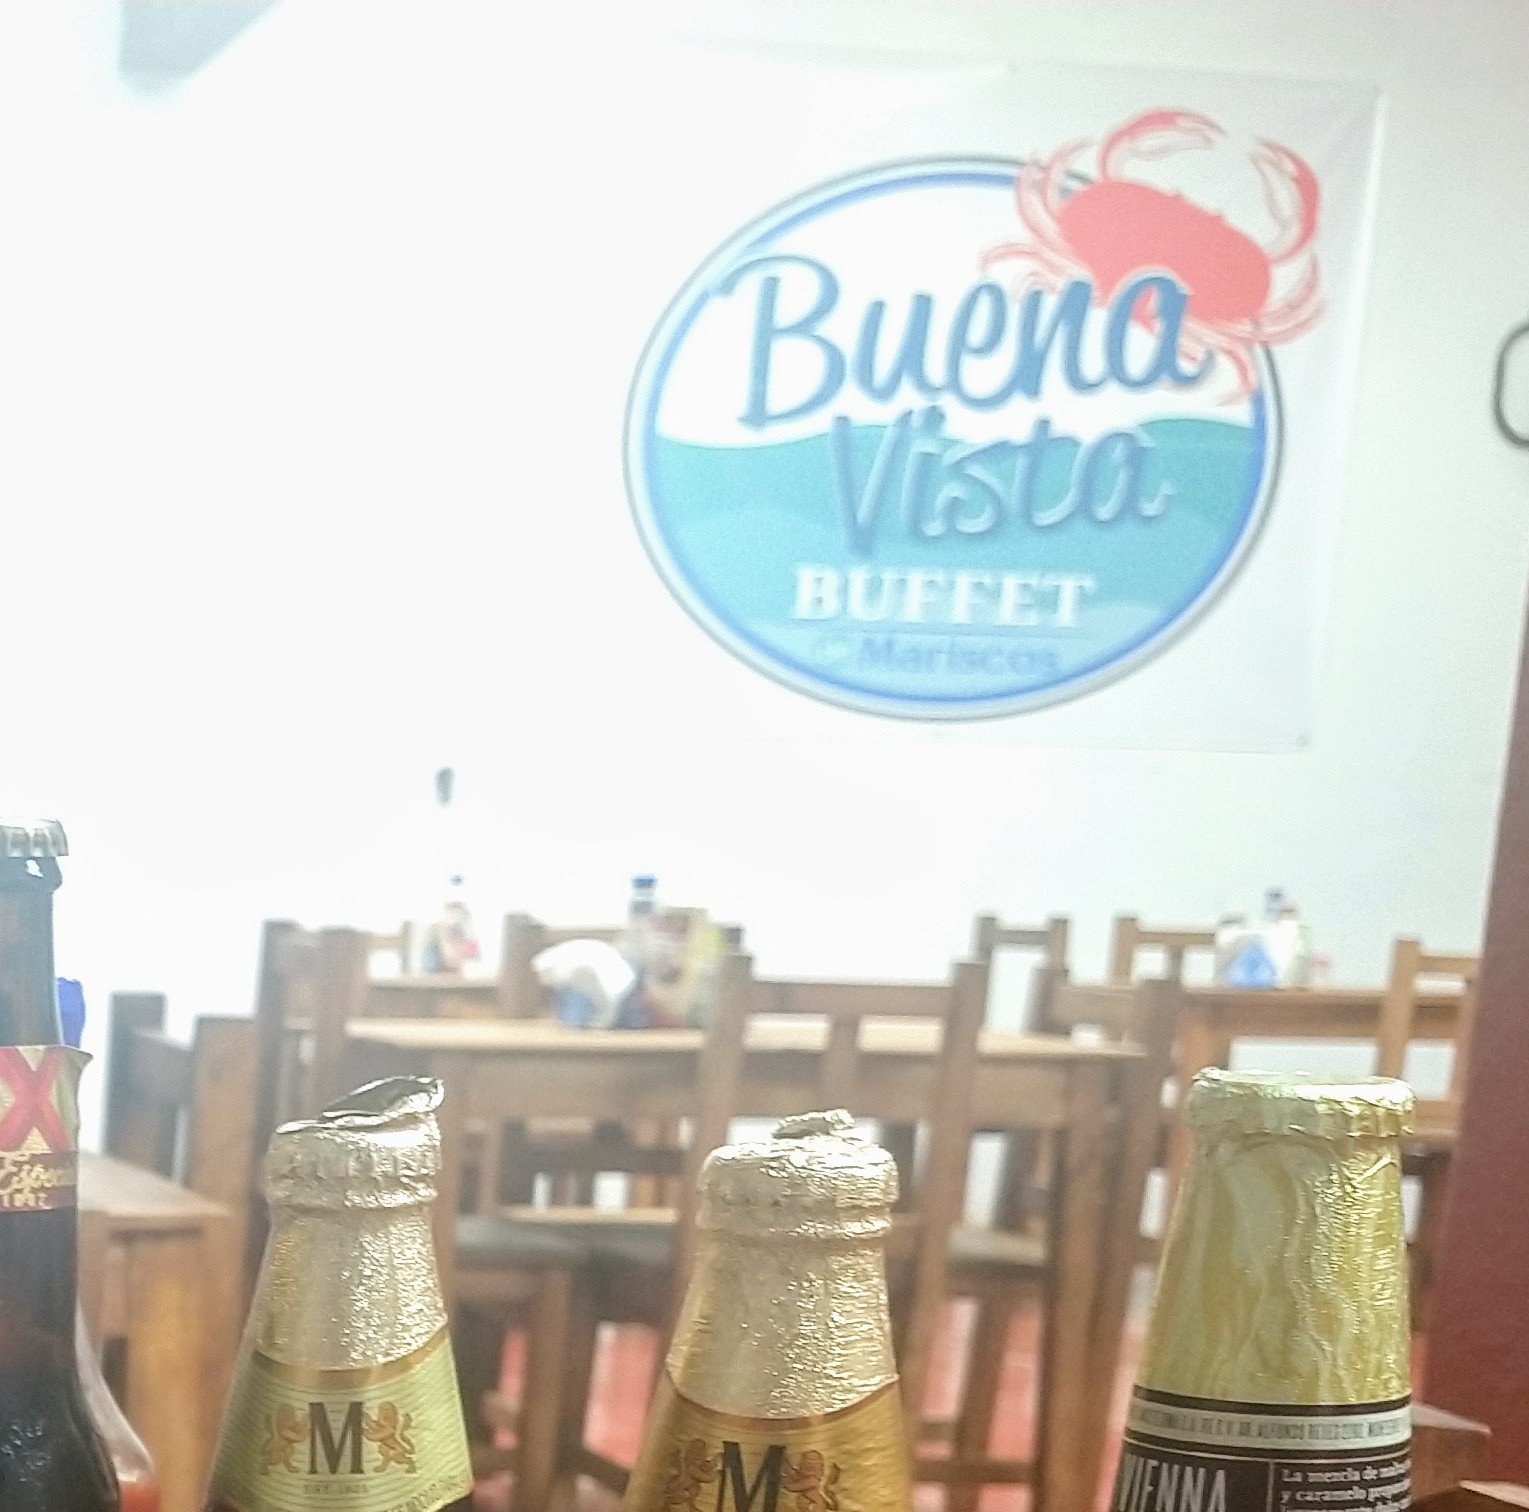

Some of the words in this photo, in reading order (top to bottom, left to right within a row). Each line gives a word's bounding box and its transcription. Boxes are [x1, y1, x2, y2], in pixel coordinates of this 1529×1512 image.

[710, 253, 1216, 429] Buena
[826, 405, 1176, 557] Vista
[790, 567, 1096, 628] BUFFET
[308, 1401, 364, 1475] M
